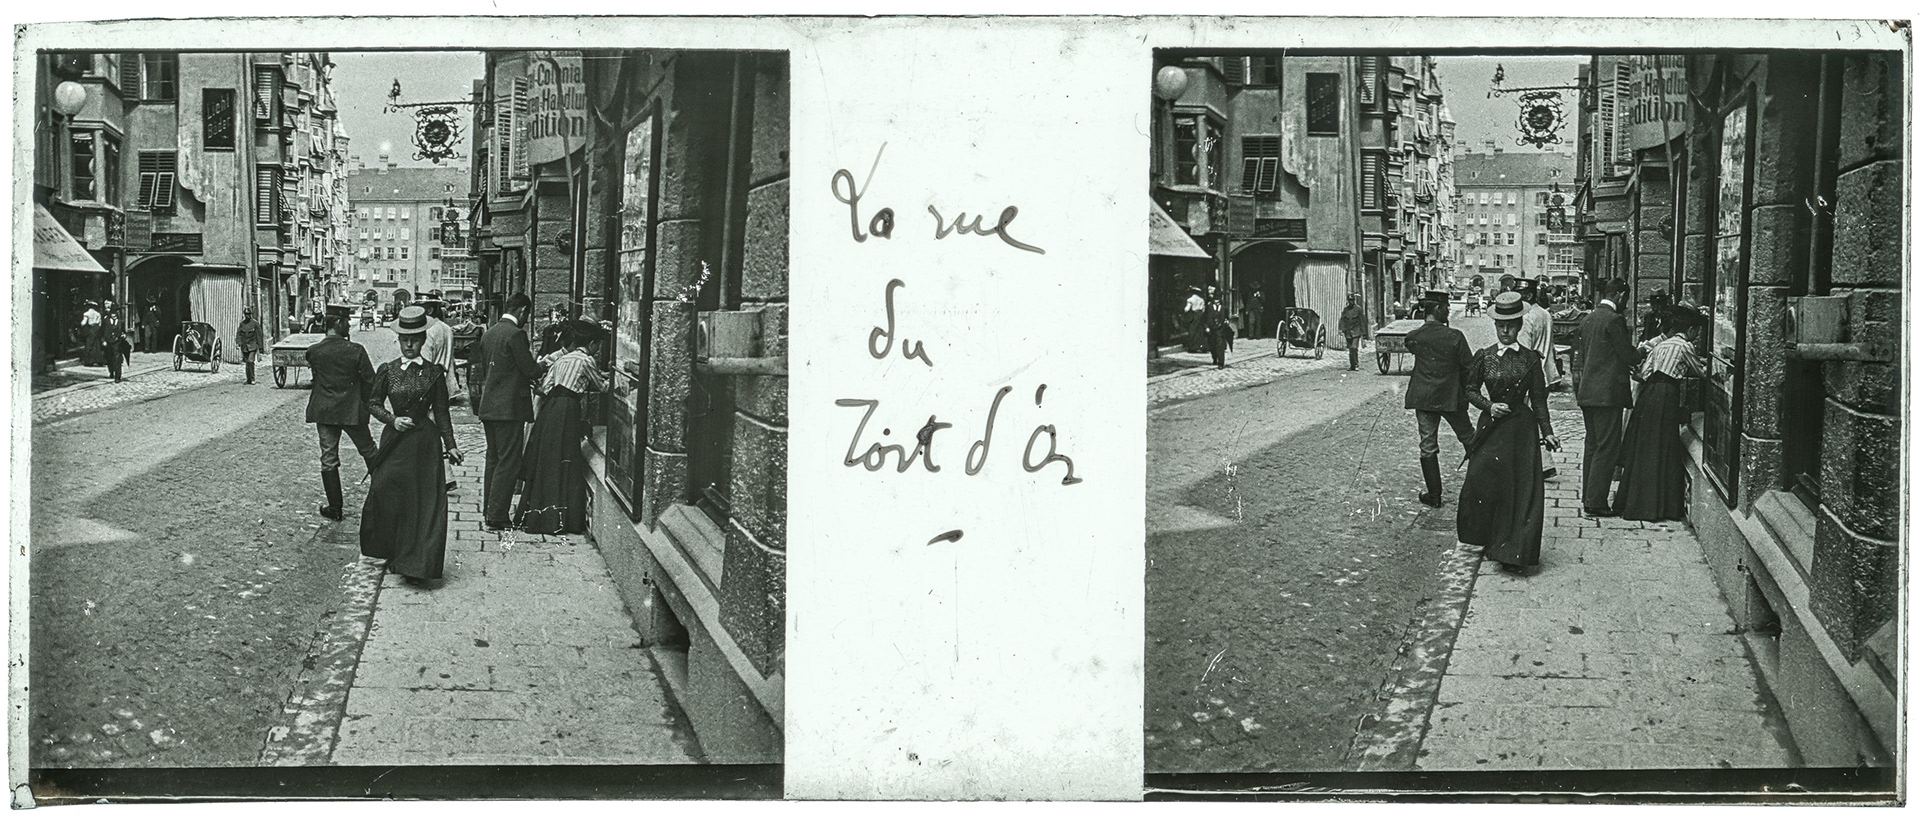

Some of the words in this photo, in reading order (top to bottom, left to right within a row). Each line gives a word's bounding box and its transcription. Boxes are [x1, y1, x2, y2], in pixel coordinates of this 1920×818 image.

[831, 142, 895, 243] La
[927, 204, 1047, 255] rue
[868, 278, 934, 368] du
